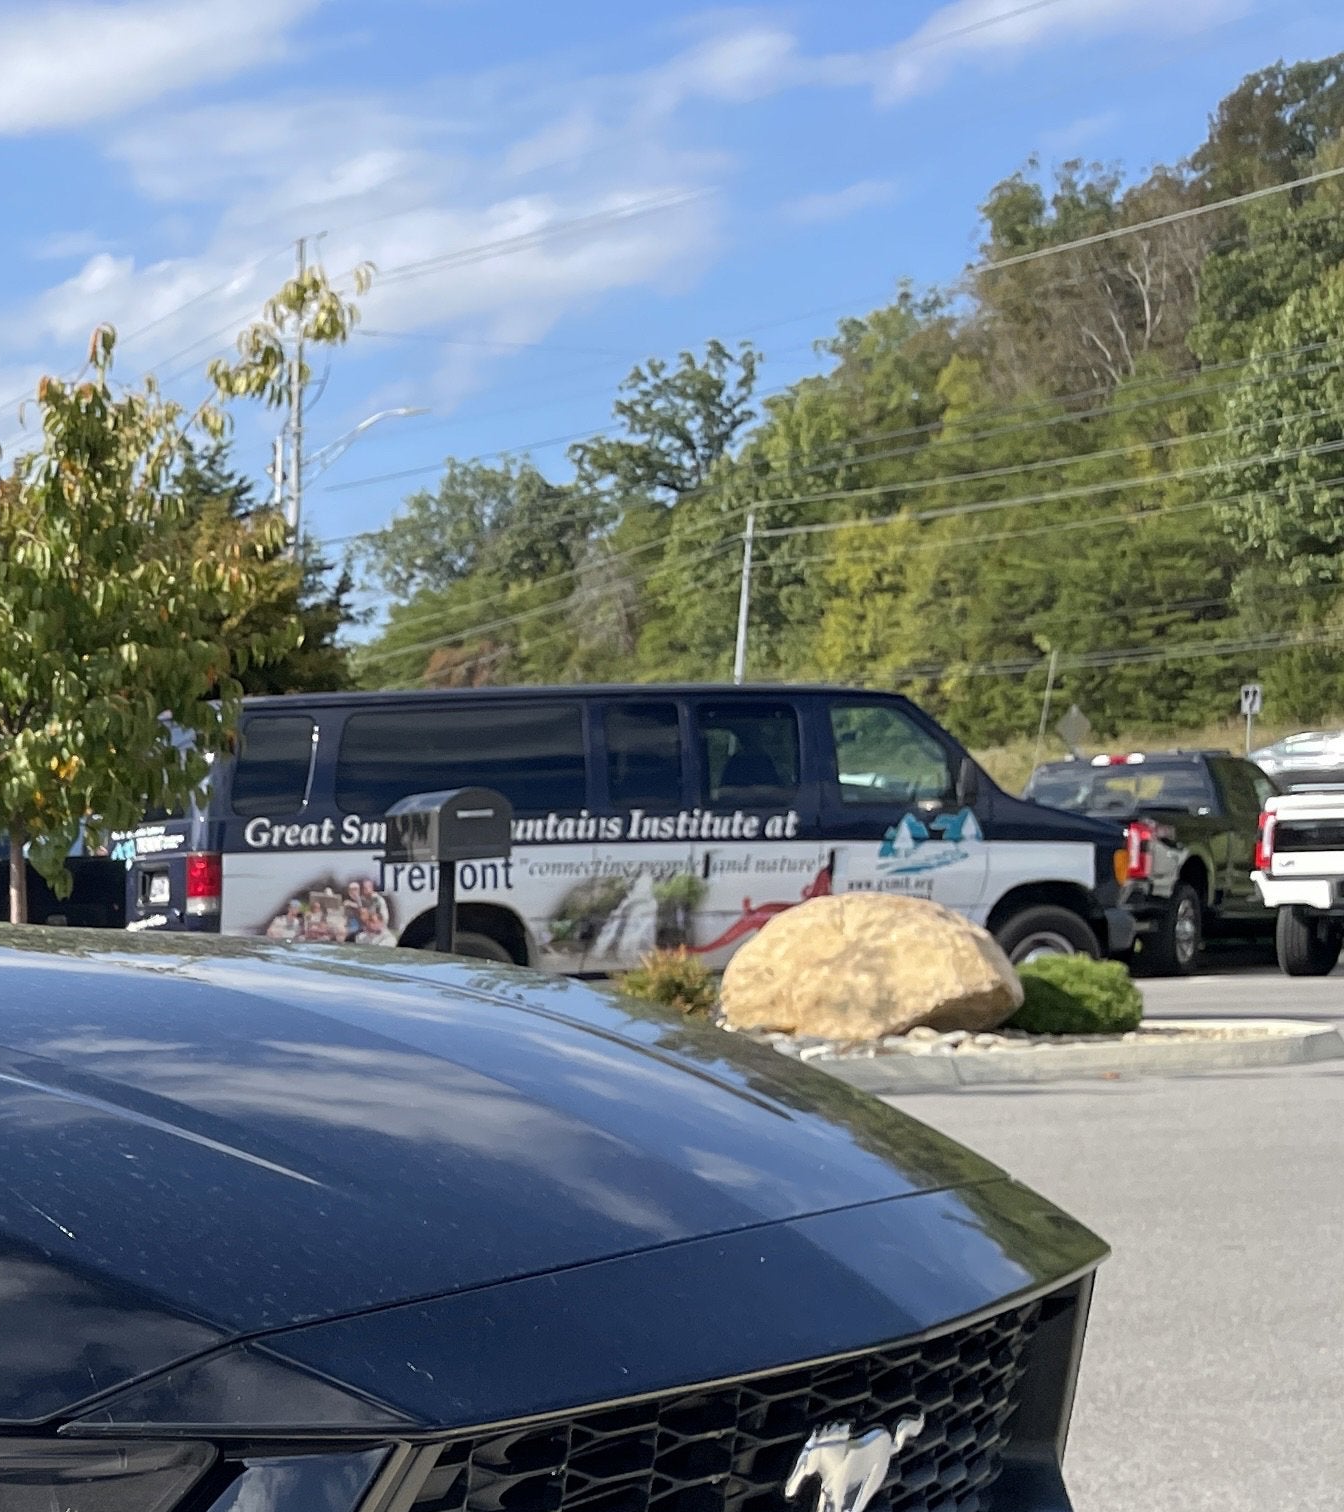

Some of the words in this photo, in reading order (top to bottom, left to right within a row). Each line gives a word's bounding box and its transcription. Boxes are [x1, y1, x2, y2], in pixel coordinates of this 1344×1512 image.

[244, 816, 335, 848] Great
[511, 809, 623, 841] untains
[627, 808, 759, 840] Institute
[765, 809, 799, 839] at
